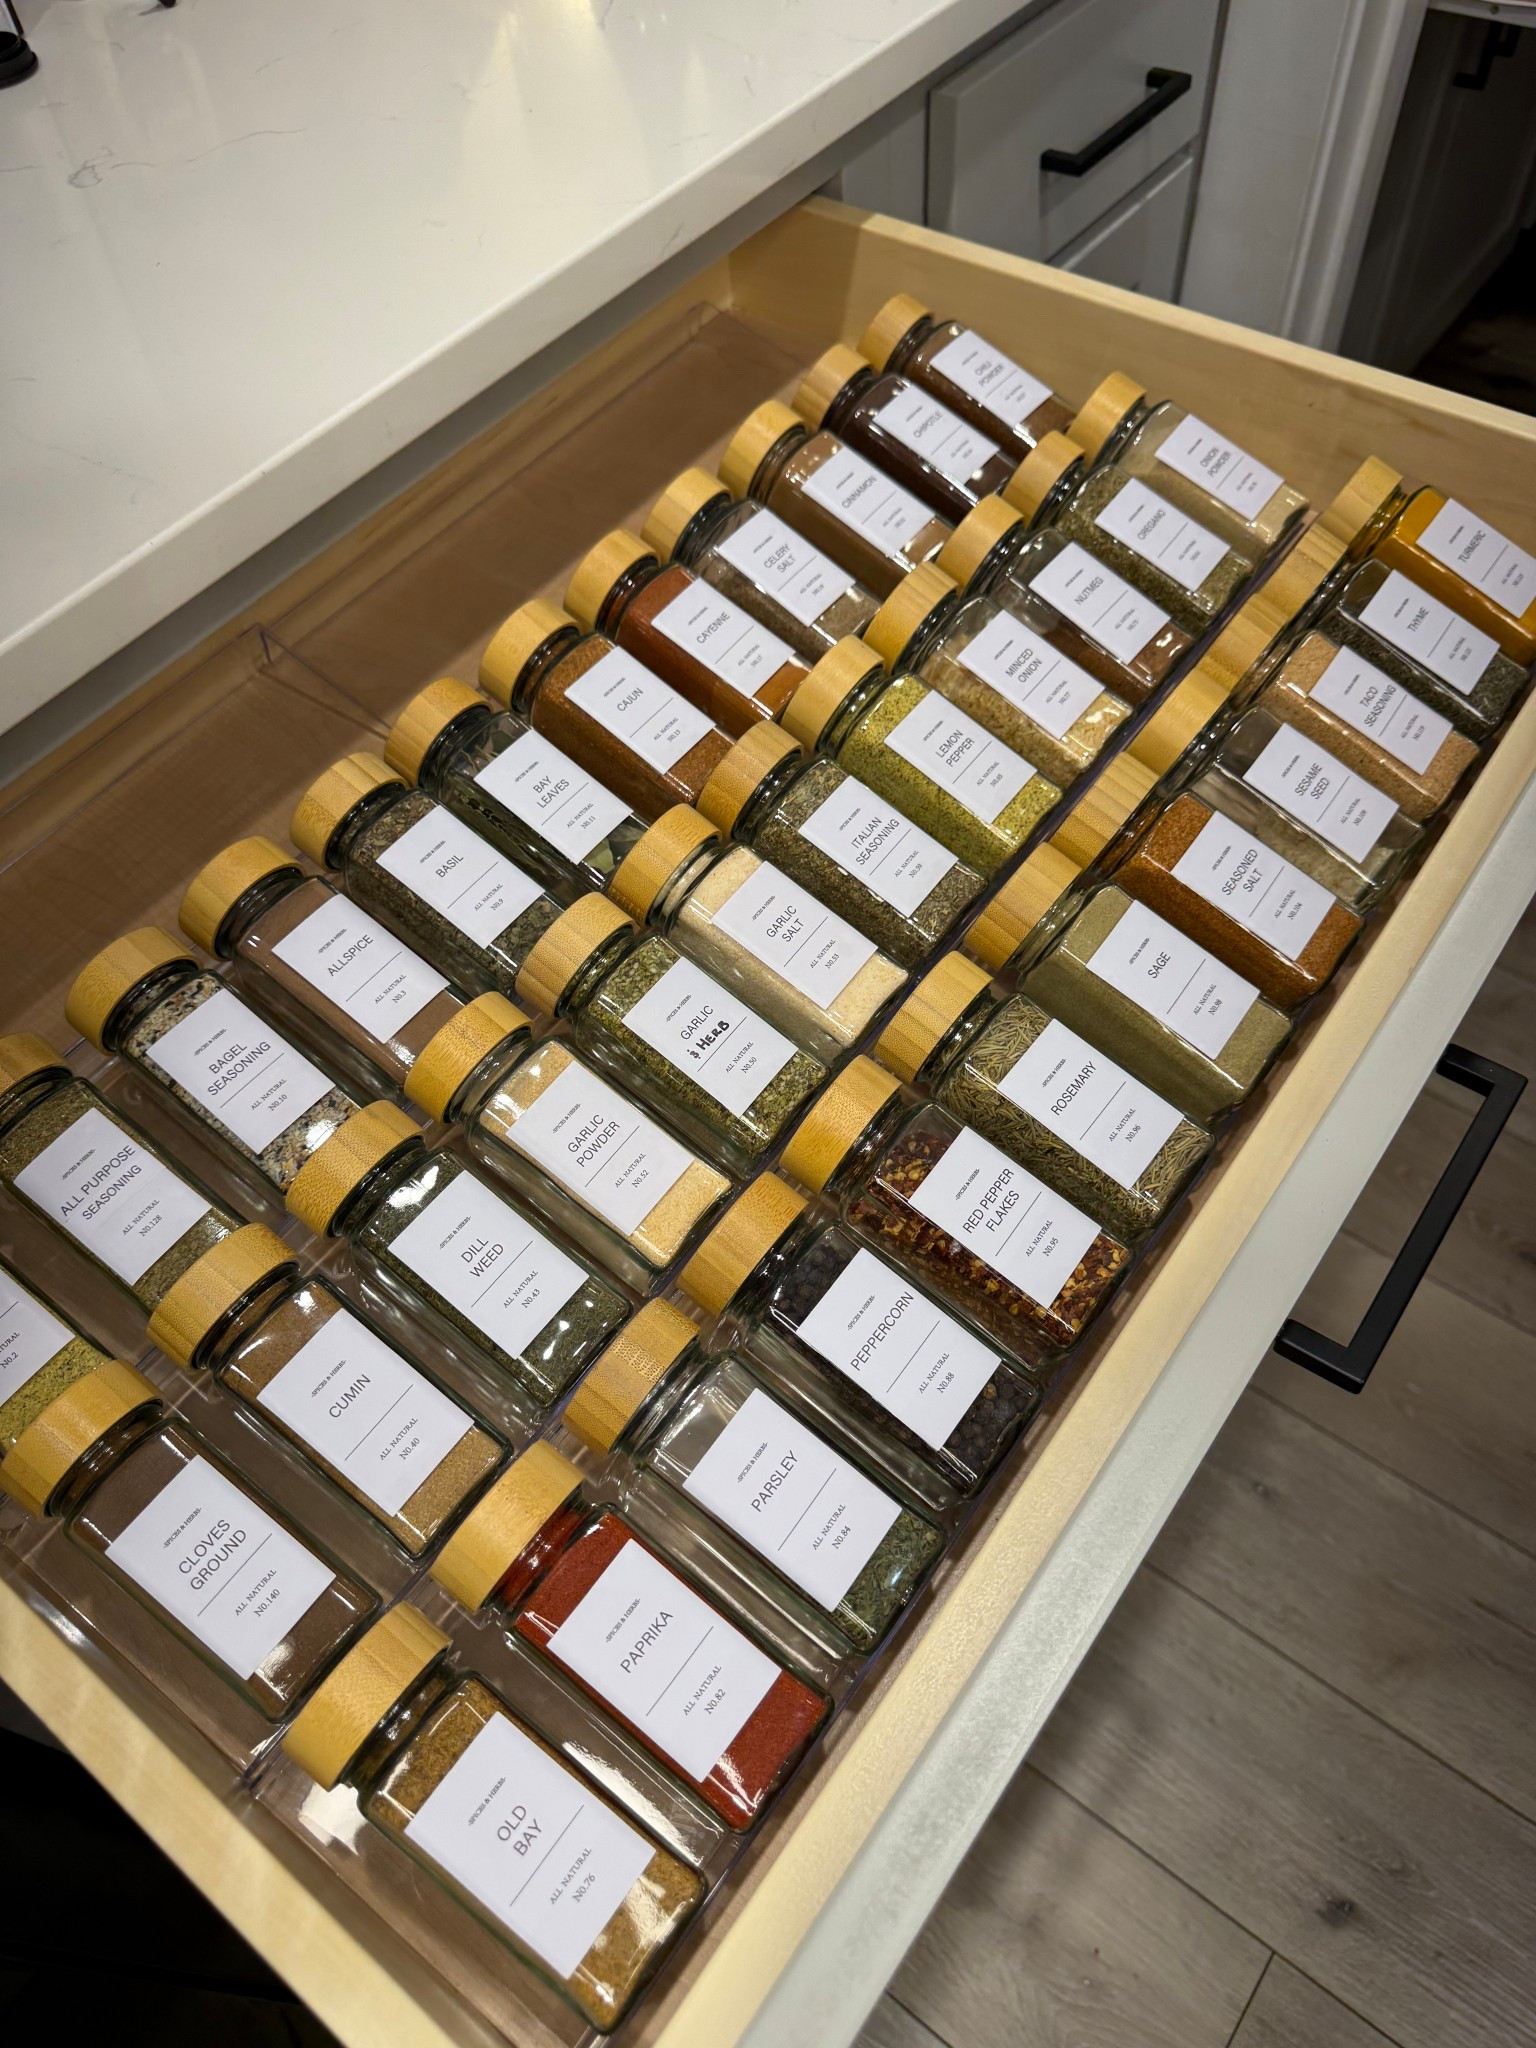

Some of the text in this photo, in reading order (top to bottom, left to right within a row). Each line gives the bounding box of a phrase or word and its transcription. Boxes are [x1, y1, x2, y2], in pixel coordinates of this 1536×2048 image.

[912, 410, 943, 438] CHIPOTLE
[1199, 446, 1219, 467] ONION
[1206, 450, 1231, 477] POWDER
[841, 475, 877, 509] CINNAMON
[1136, 508, 1166, 540] OREGANO
[763, 543, 790, 568] CELERY
[1457, 529, 1486, 563] TURMERIC
[776, 553, 795, 573] SALT
[1074, 576, 1104, 605] NUTMEG
[696, 611, 731, 644] CAYENNE
[1406, 606, 1429, 632] THYME
[1004, 648, 1033, 677] MINCED
[1017, 657, 1042, 683] ONION
[616, 687, 644, 711] CAJUN
[1359, 686, 1378, 707] TACO
[1363, 684, 1397, 727] SEASONING
[935, 729, 963, 758] LEMON
[945, 737, 975, 767] PEPPER
[532, 775, 552, 793] BAY
[536, 778, 570, 808] LEAVES
[1294, 762, 1323, 796] SESAME
[1310, 777, 1330, 800] SEED
[566, 803, 594, 828] ALL NATURAL
[851, 816, 882, 849] ITALIAN
[855, 818, 900, 865] SEASONING
[435, 854, 464, 878] BASIL
[894, 850, 919, 877] ALL NATURAL
[1221, 848, 1258, 896] SEASONED
[1242, 867, 1262, 892] SALT
[474, 883, 503, 911] ALL NATURAL
[1274, 889, 1295, 918] ALL NATURAL
[766, 905, 797, 937] GARLIC
[781, 917, 804, 942] SALT
[327, 934, 374, 977] ALLSPICE
[809, 939, 836, 968] ALL NATURAL
[1147, 951, 1171, 979] SAGE
[374, 974, 406, 1004] ALL NATURAL
[1193, 983, 1216, 1015] ALL NATURAL
[680, 1005, 713, 1039] GARLIC
[695, 1020, 730, 1051] HERB
[207, 1041, 271, 1096] SEASONING
[208, 1043, 247, 1074] BAGEL
[725, 1041, 753, 1072] ALL NATURAL
[251, 1078, 286, 1110] ALL NATURAL
[1050, 1060, 1096, 1116] ROSEMARY
[567, 1114, 604, 1152] GARLIC
[1108, 1108, 1136, 1142] ALL NATURAL
[575, 1121, 620, 1167] POWDER
[60, 1145, 136, 1217] ALL PURPOSE
[614, 1153, 646, 1188] ALL NATURAL
[82, 1164, 142, 1220] SEASONING
[962, 1168, 1014, 1234] RED PEPPER
[122, 1199, 159, 1235] ALL NATURAL
[985, 1190, 1019, 1232] FLAKES
[460, 1238, 489, 1263] DILL
[1025, 1220, 1052, 1257] ALL NATURAL
[469, 1243, 504, 1277] WEED
[503, 1270, 538, 1308] ALL NATURAL
[0, 1332, 20, 1354] TURAL
[849, 1291, 914, 1371] PEPPERCORN
[918, 1353, 949, 1394] ALL NATURAL
[328, 1373, 371, 1418] CUMIN
[379, 1417, 418, 1461] ALL NATURAL
[750, 1449, 797, 1512] PARSLEY
[812, 1504, 846, 1550] ALL NATURAL
[178, 1519, 230, 1574] CLOVES
[190, 1529, 246, 1590] GROUND
[235, 1569, 276, 1616] ALL NATURAL
[619, 1611, 674, 1674] PAPRIKA
[683, 1665, 722, 1716] ALL NATURAL
[496, 1805, 527, 1841] OLD
[512, 1817, 542, 1856] BAY
[550, 1848, 592, 1905] ALL NATURAL
